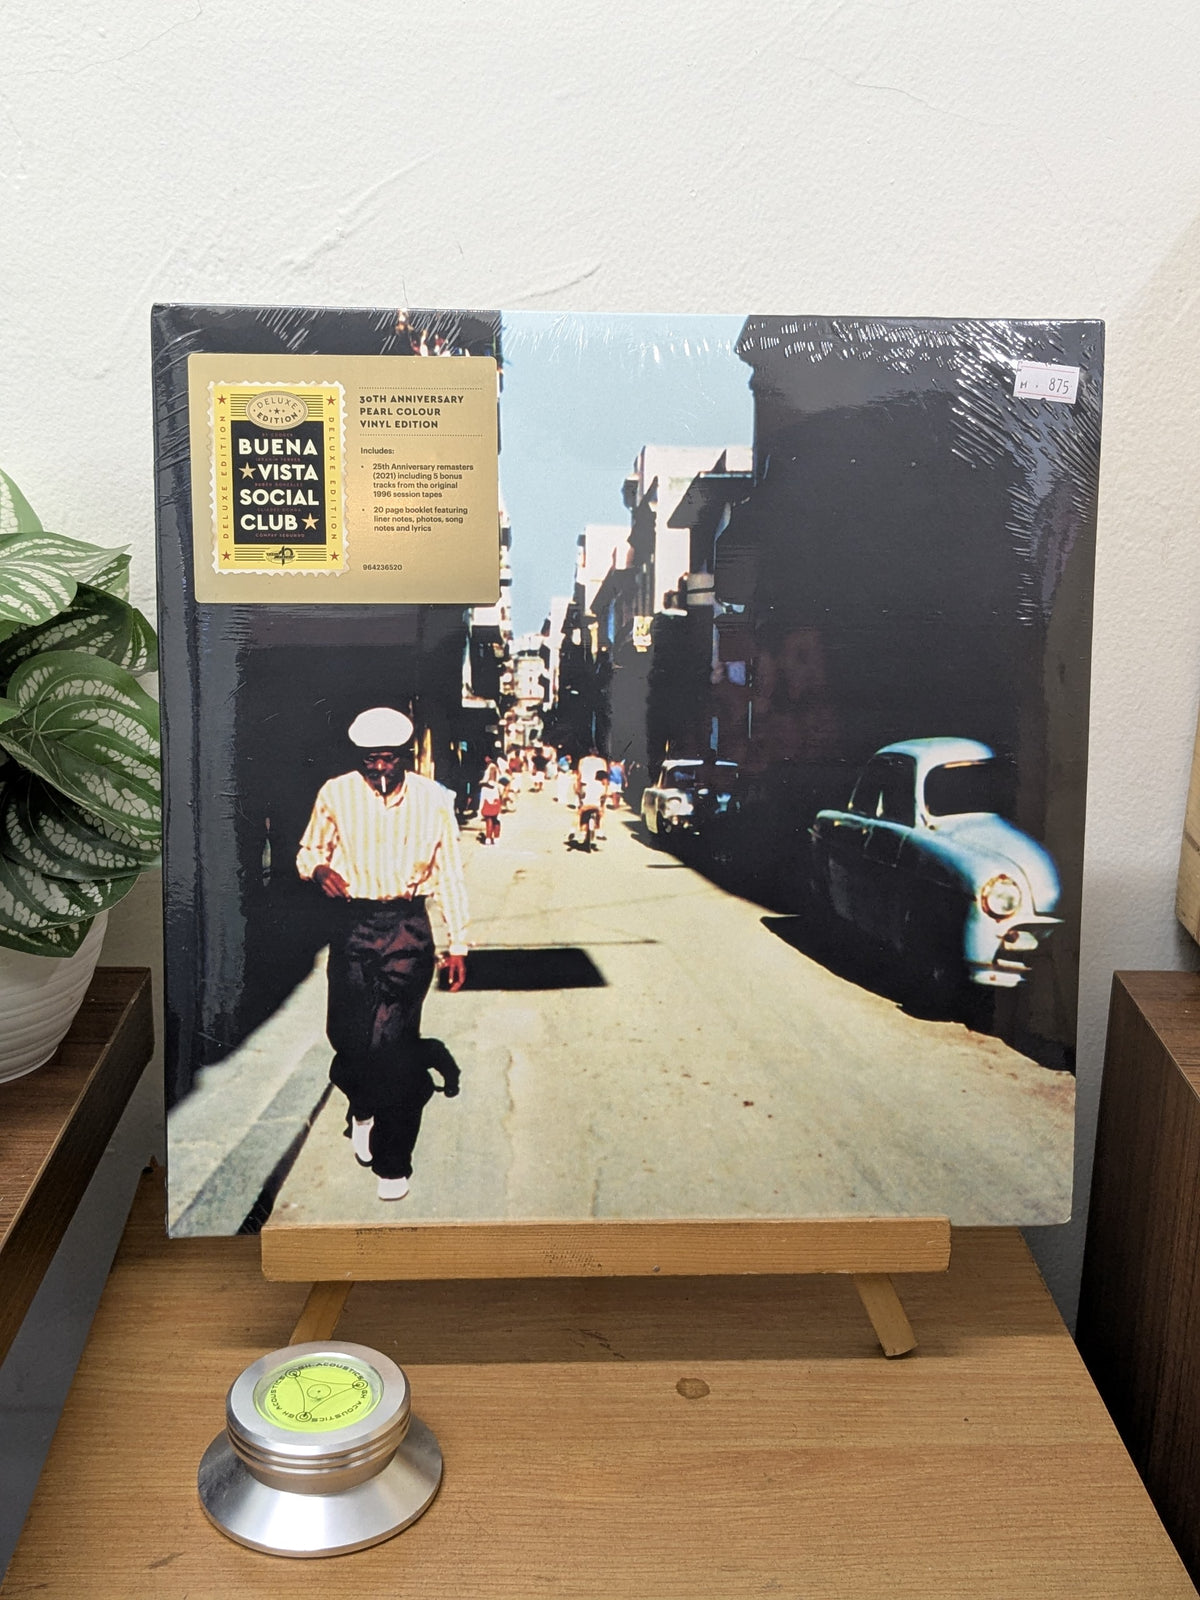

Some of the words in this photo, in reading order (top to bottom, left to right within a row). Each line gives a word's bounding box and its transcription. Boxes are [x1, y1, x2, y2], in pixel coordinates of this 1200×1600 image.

[1048, 377, 1069, 395] 875
[256, 396, 298, 409] DELUXE
[359, 395, 387, 404] 30TH
[390, 395, 464, 404] ANNIVERSARY
[256, 411, 298, 424] EDITION
[359, 407, 393, 416] PEARL
[396, 408, 441, 416] COLOUR
[359, 420, 392, 428] VINYL
[394, 420, 438, 428] EDITION
[220, 416, 228, 476] EDITION
[238, 438, 318, 456] BUENA
[328, 417, 336, 471] DELUXE
[360, 447, 395, 455] Includes:
[258, 464, 319, 481] VISTA
[390, 463, 436, 472] Anniversary
[372, 472, 396, 480] (2021)
[397, 472, 432, 481] including
[439, 472, 463, 480] bonus
[430, 482, 458, 490] original
[240, 488, 320, 506] SOCIAL
[422, 491, 443, 499] tapes
[221, 486, 229, 539] DELUXE
[330, 480, 338, 540] EDITION
[434, 506, 468, 515] featuring
[240, 514, 299, 531] CLUB
[391, 516, 415, 524] notes,
[416, 516, 444, 524] photos,
[411, 525, 432, 533] lyrics
[316, 1362, 364, 1380] ACOUSTICS
[270, 1375, 286, 1410] ACOUSTICS
[311, 1400, 362, 1422] ACOUSTICS
